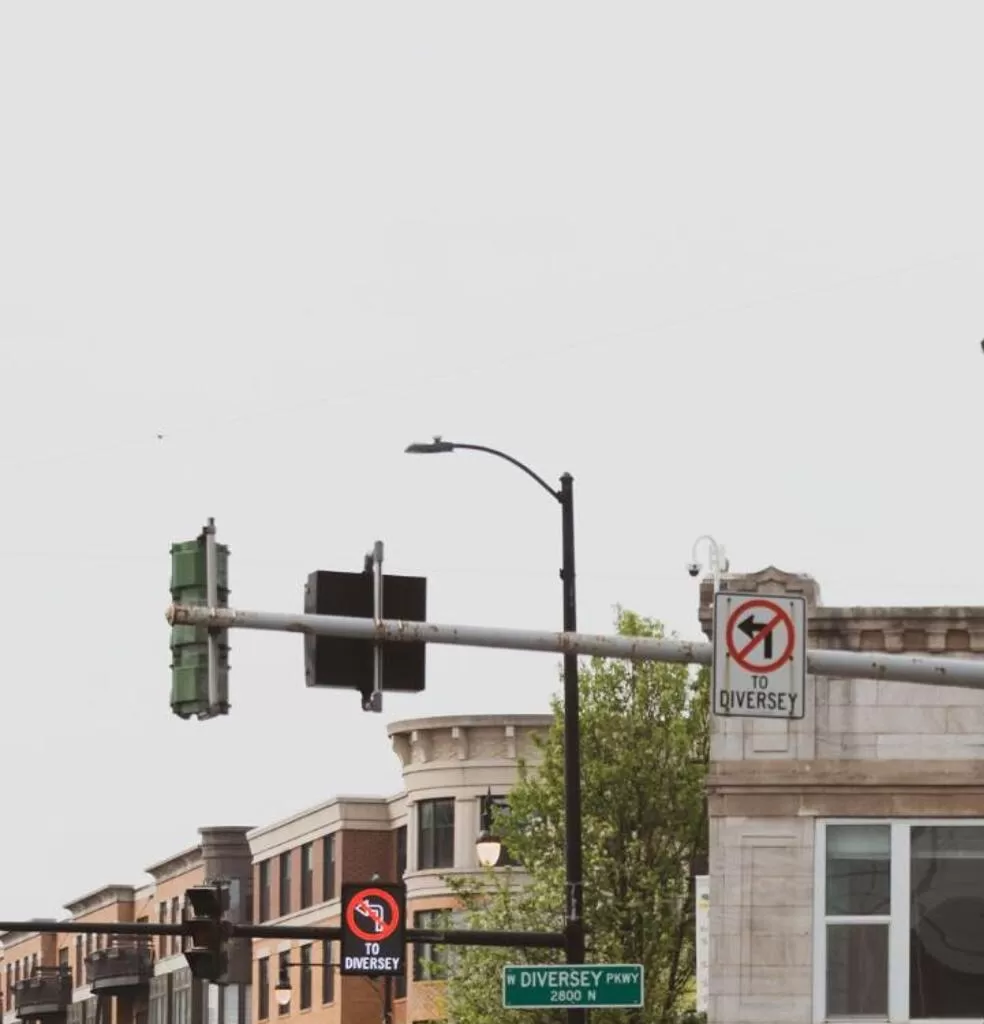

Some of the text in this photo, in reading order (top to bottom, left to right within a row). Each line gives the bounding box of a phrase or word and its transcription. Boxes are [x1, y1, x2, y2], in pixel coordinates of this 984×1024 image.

[751, 675, 768, 690] TO
[719, 690, 798, 711] DIVERSEY
[364, 942, 380, 956] TO
[344, 956, 400, 970] DIVERSEY
[506, 970, 640, 988] W DIVERSEY PKWY
[549, 990, 597, 1002] 2800 N
